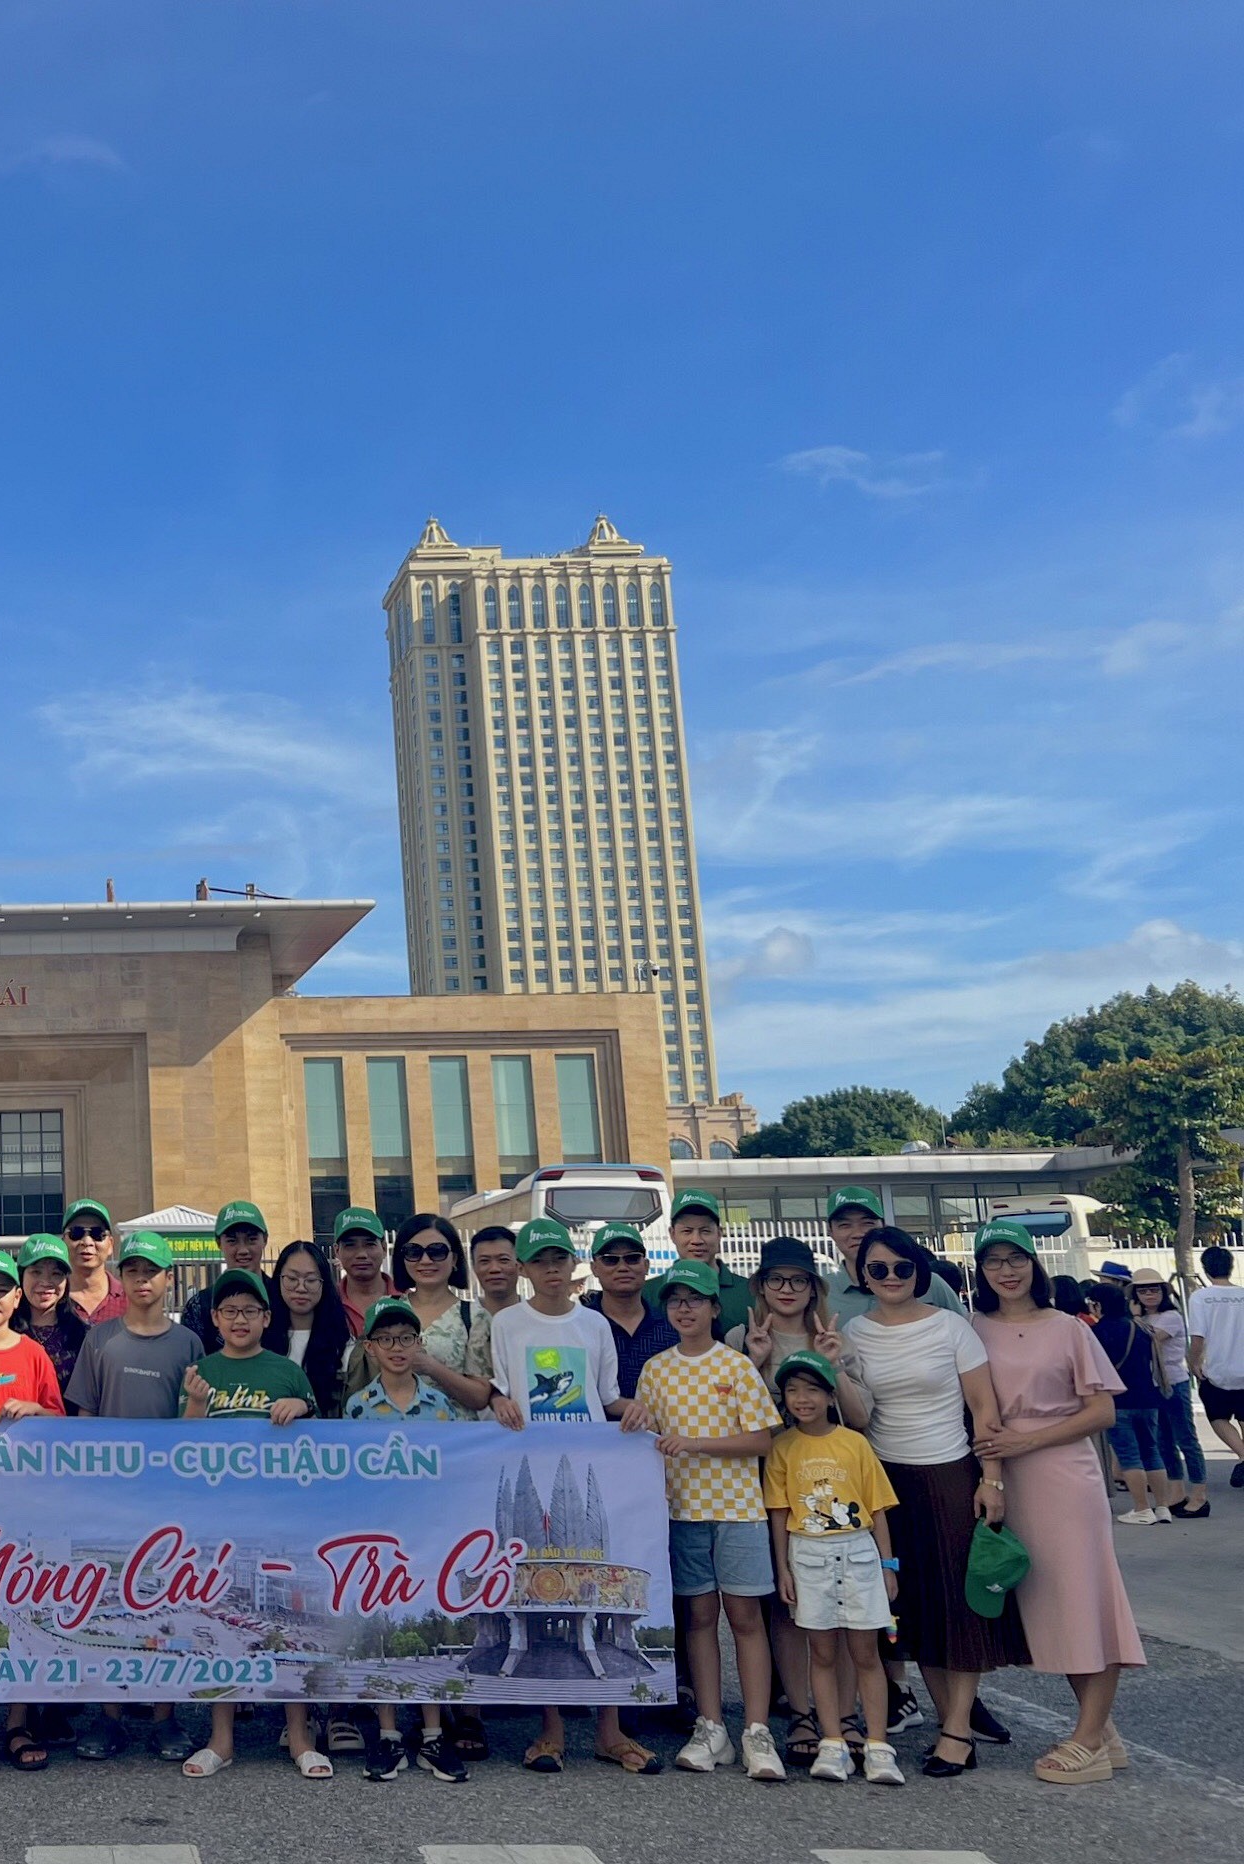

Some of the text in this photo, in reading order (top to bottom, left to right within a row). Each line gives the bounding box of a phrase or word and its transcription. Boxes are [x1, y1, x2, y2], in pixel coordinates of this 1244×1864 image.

[533, 1412, 591, 1422] SHARK CREW
[56, 1445, 142, 1474] NHU
[173, 1444, 257, 1483] CỤC
[263, 1438, 347, 1483] HẬU
[357, 1435, 439, 1476] CẦN
[123, 1526, 233, 1611] Cái
[318, 1533, 426, 1612] Trà
[437, 1528, 524, 1613] Cổ
[46, 1659, 78, 1684] 21
[106, 1658, 274, 1685] 23/7/2023
